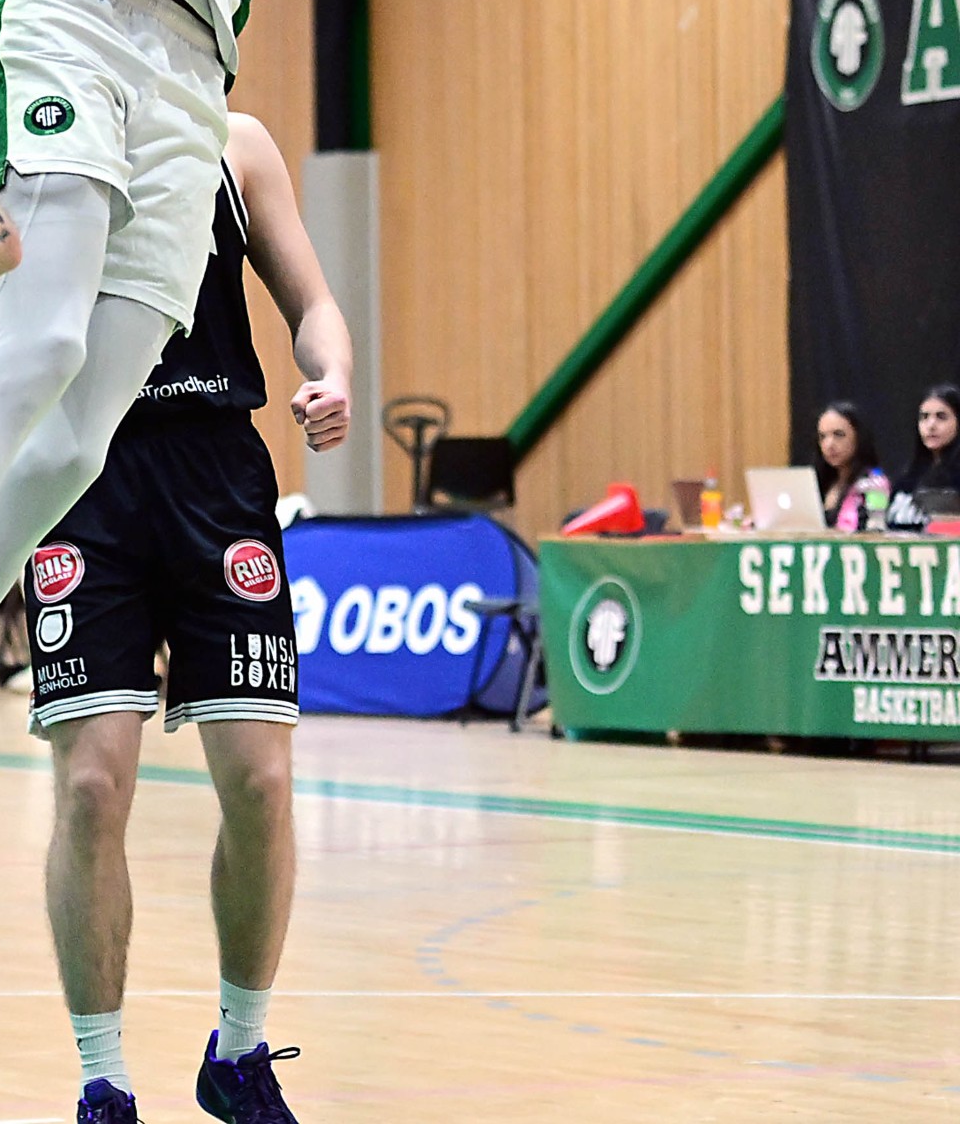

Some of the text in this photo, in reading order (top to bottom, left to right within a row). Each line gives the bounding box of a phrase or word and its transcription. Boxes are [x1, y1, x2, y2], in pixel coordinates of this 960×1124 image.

[35, 105, 63, 127] AIF
[35, 552, 75, 584] RIIS
[233, 554, 274, 583] RIIS
[329, 583, 484, 656] OBOS
[37, 656, 86, 685] MULTI
[853, 686, 960, 725] BASKETBA
